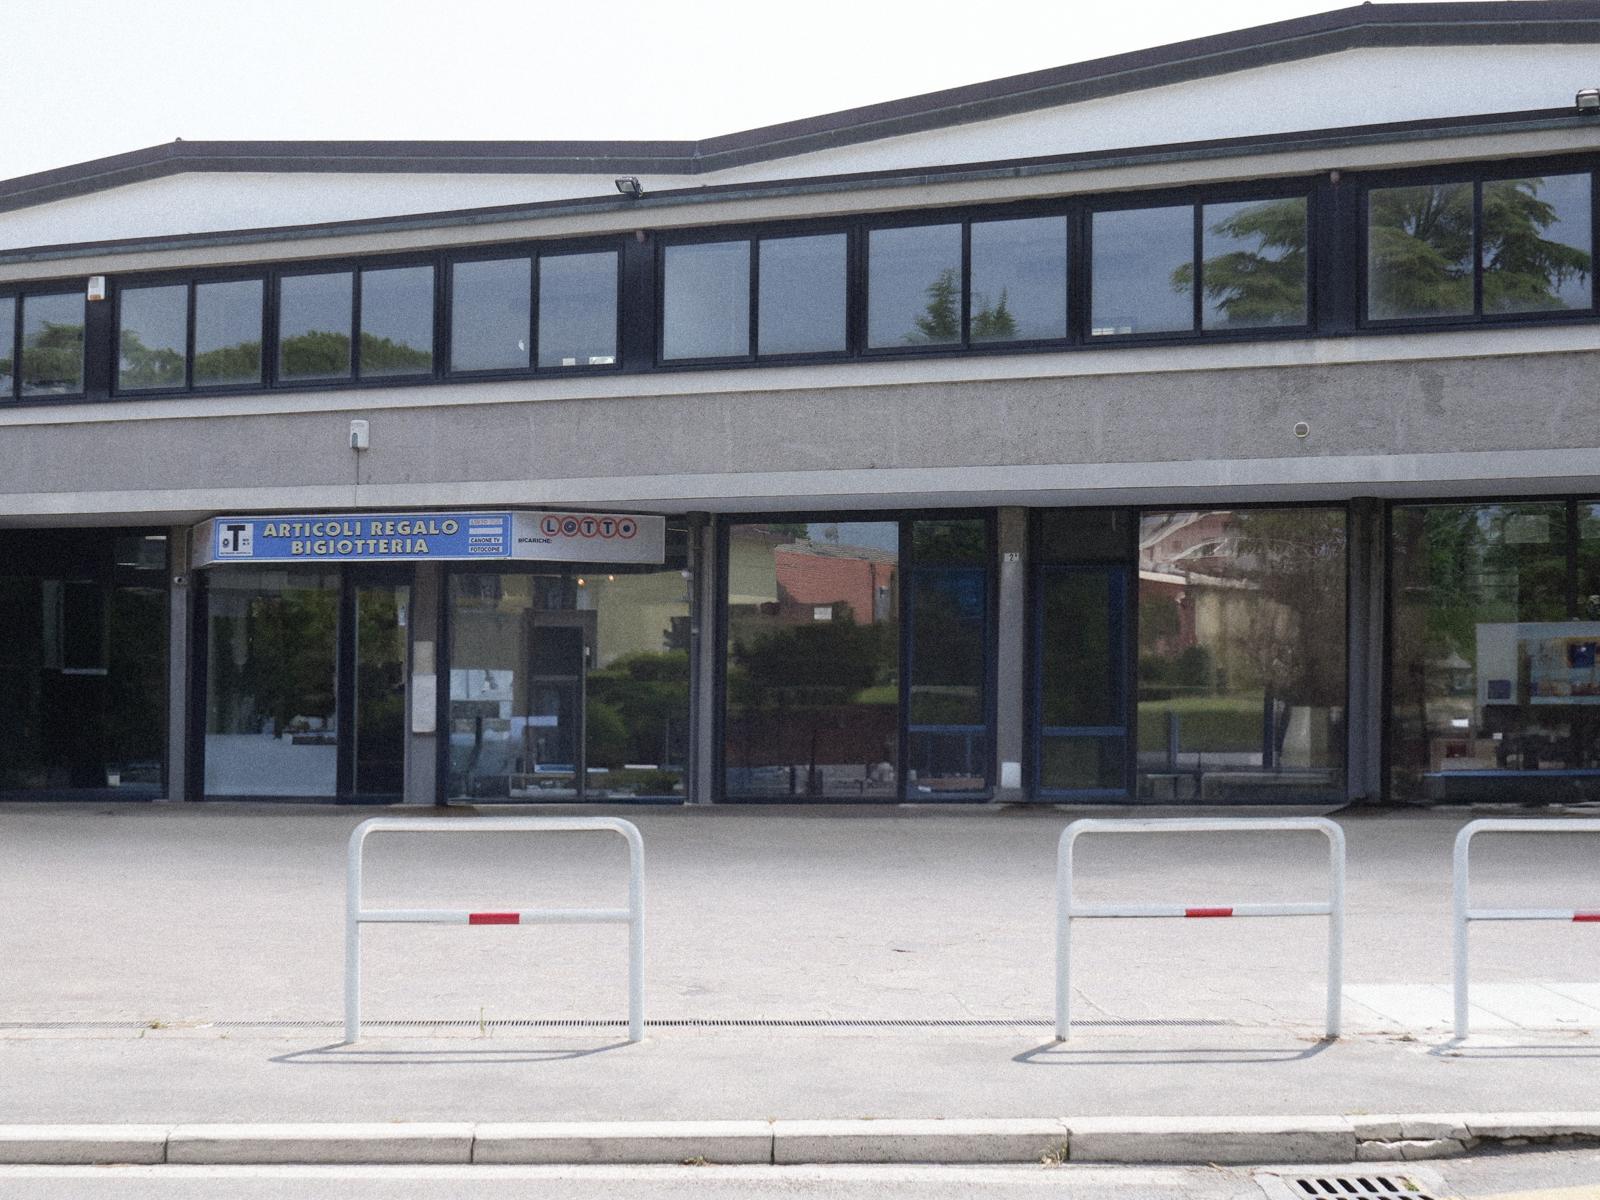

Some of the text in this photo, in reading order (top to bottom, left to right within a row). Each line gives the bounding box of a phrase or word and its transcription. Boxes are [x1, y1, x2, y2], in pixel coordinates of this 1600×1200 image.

[227, 525, 246, 551] T
[262, 519, 459, 538] ARTICOLI REGALO
[291, 539, 429, 555] BIGIOTTERIA
